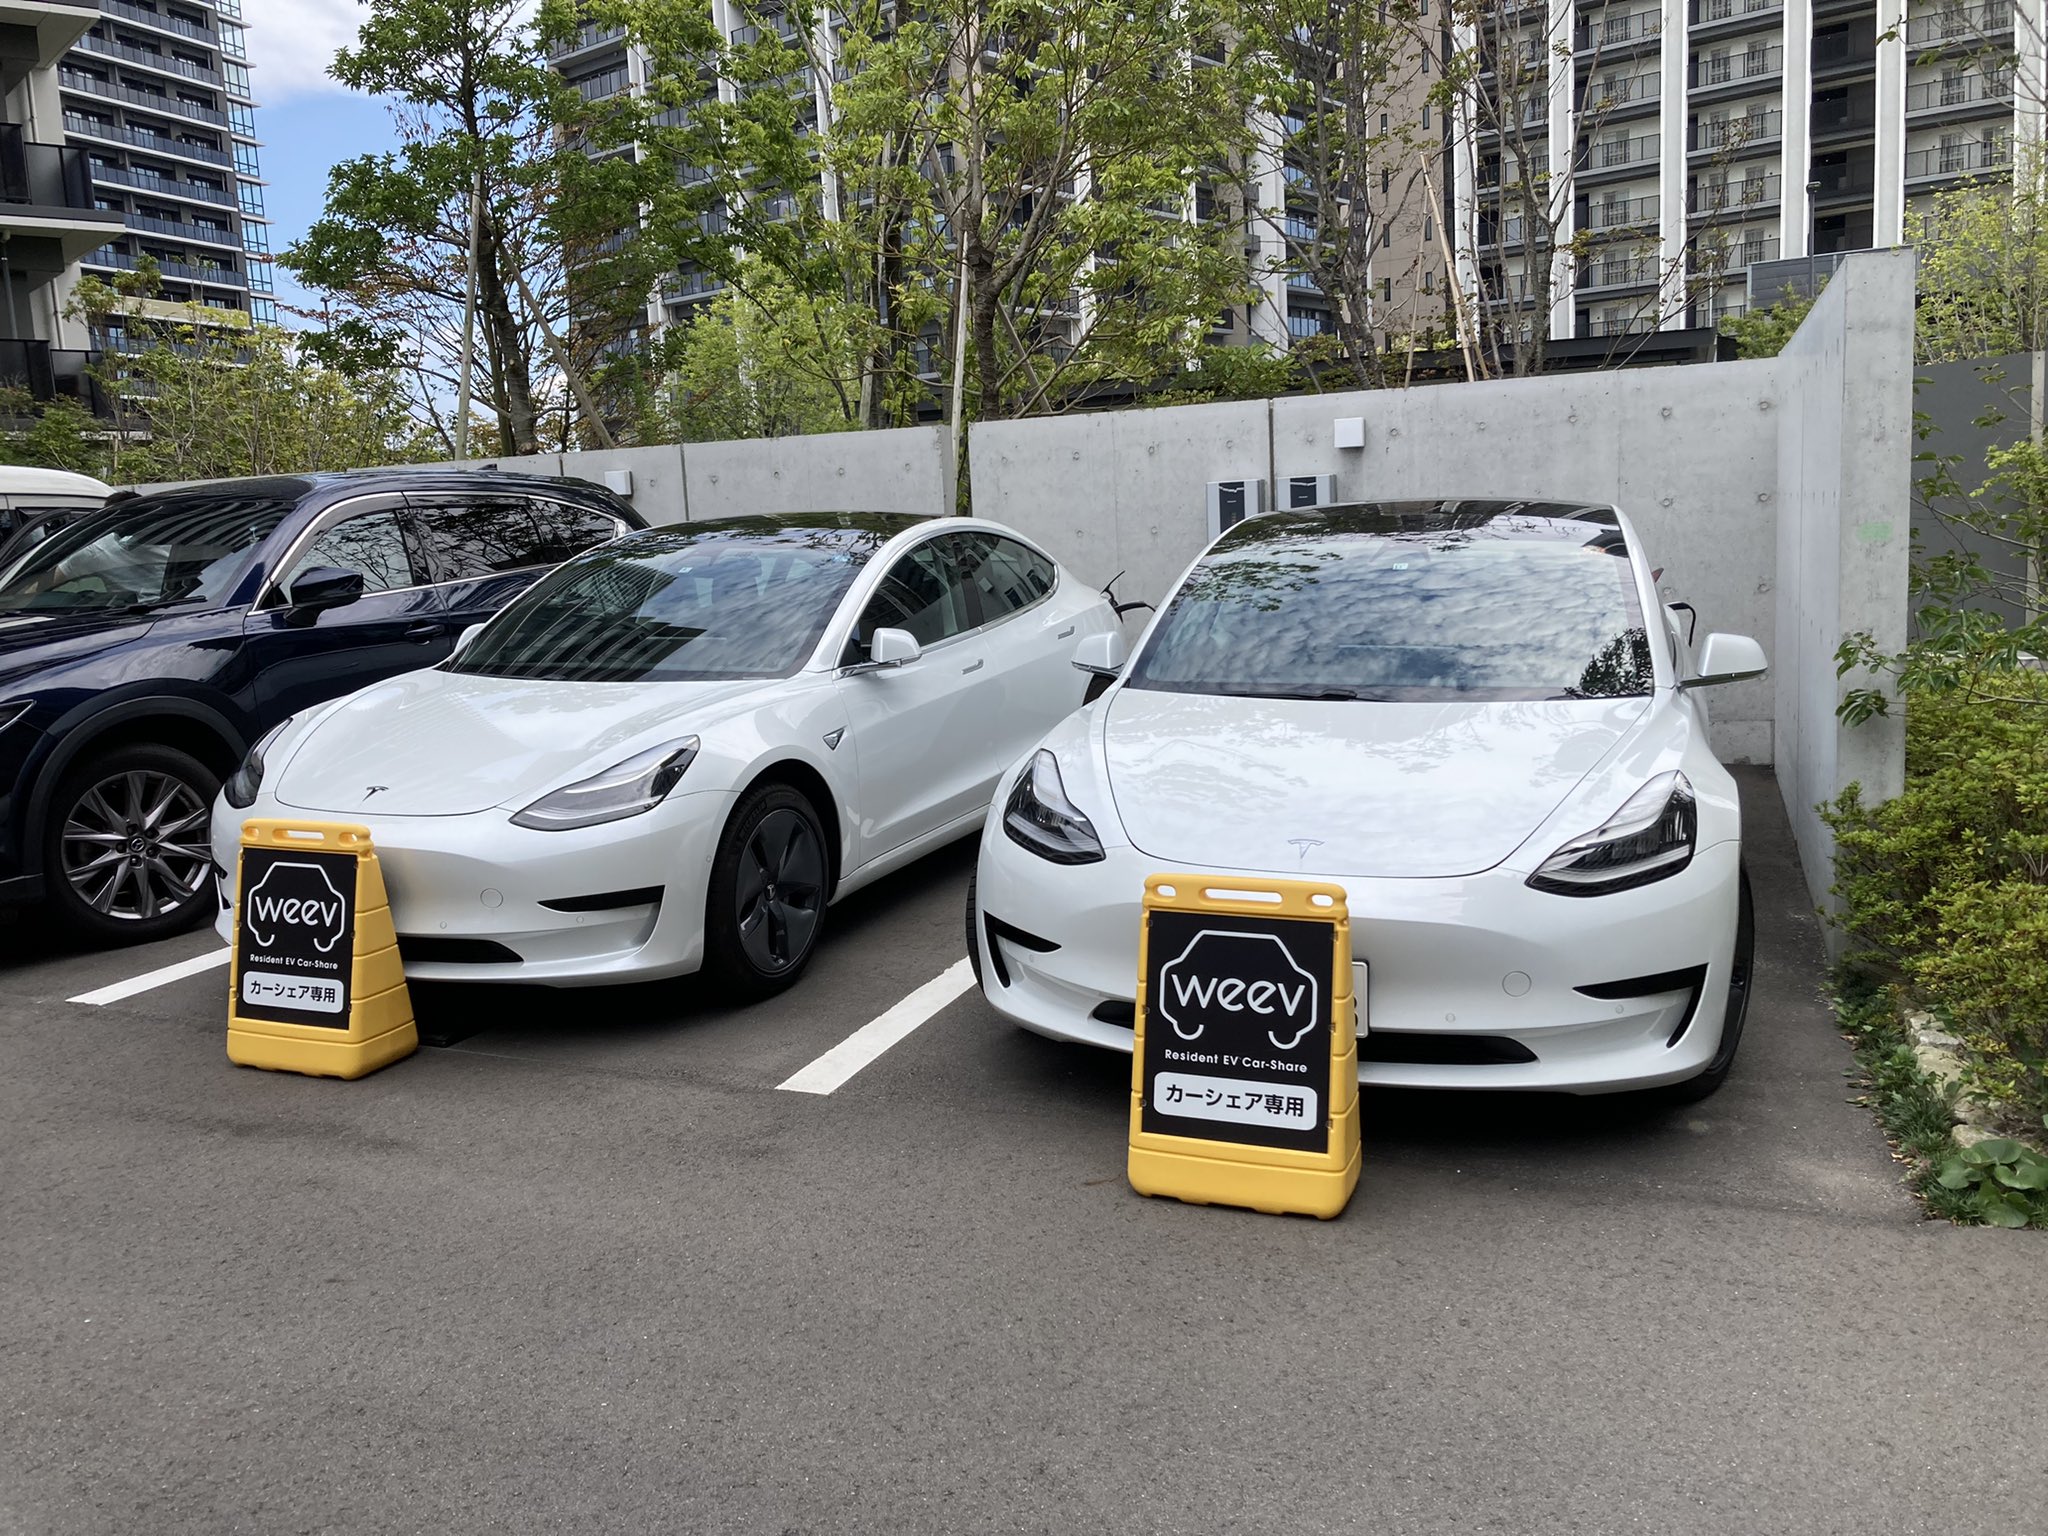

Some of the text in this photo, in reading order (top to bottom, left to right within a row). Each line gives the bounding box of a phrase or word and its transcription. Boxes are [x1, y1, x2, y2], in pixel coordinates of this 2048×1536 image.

[255, 896, 338, 927] weev
[250, 953, 338, 970] Resident EV Car-Share
[250, 980, 336, 1003] カーシェア専用
[1172, 974, 1305, 1017] weev
[1164, 1049, 1308, 1073] Resident EV Car-Share
[1165, 1084, 1304, 1118] カーシェア専用
